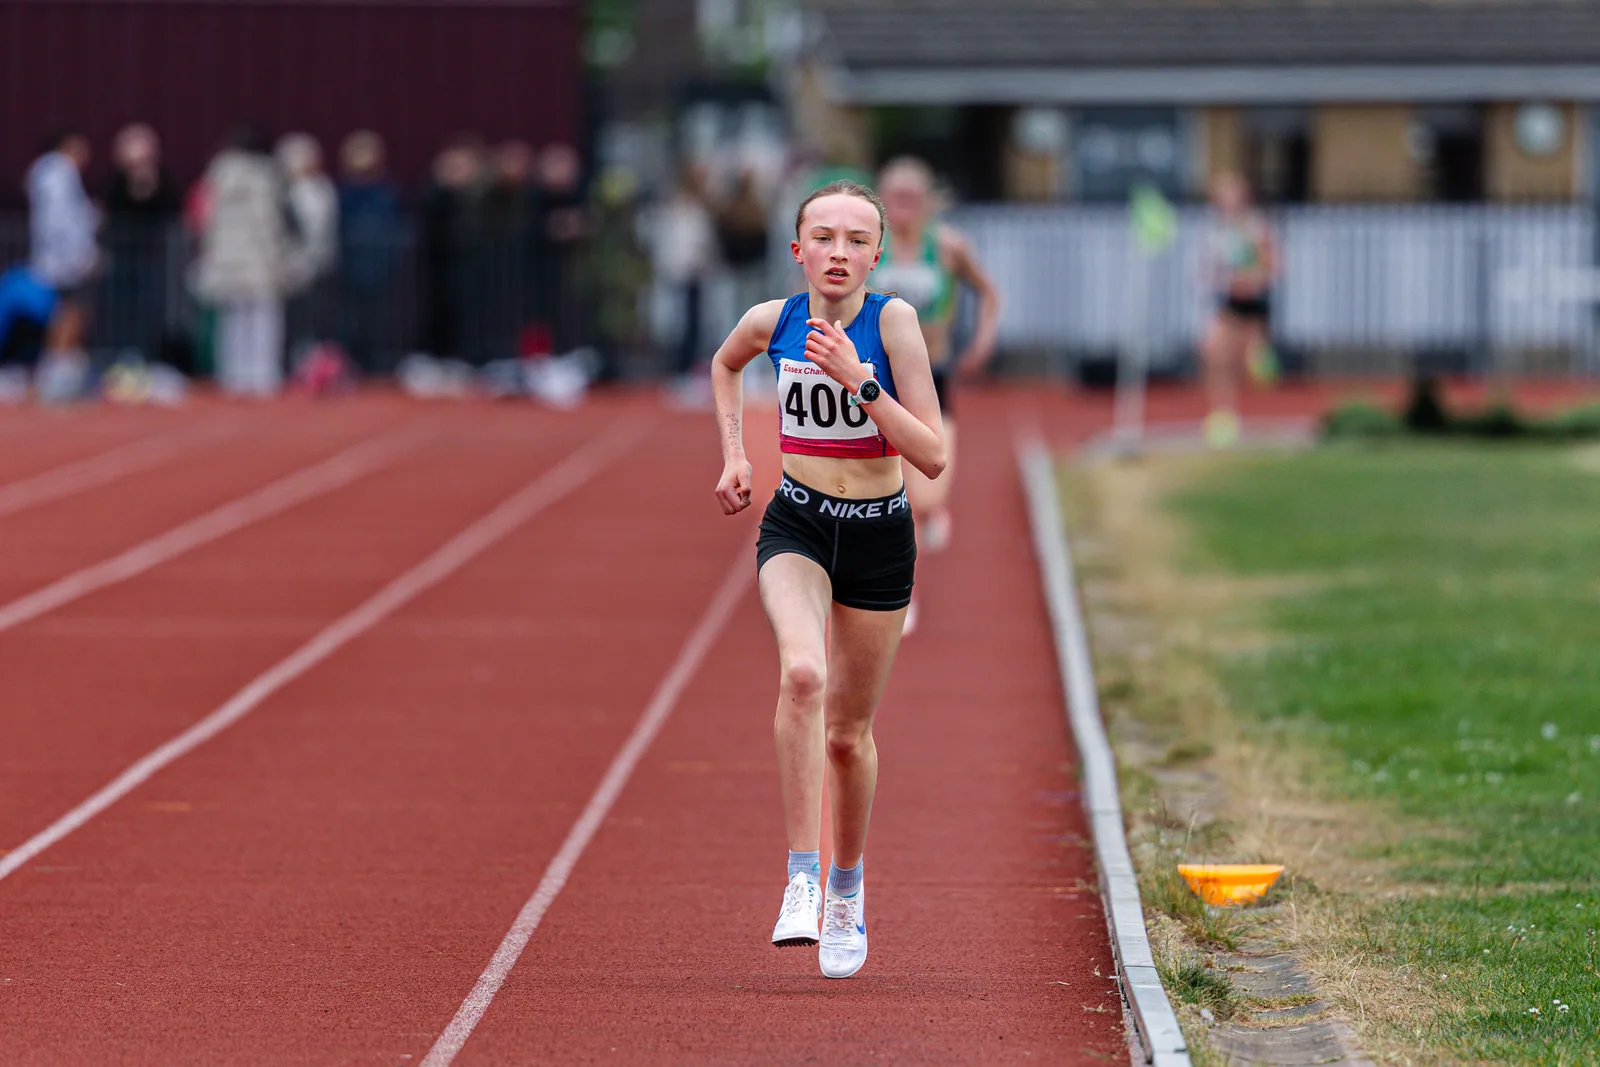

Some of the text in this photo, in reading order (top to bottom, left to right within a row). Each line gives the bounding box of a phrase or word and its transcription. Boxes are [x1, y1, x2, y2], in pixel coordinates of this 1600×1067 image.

[783, 364, 829, 378] Essex Cham
[785, 381, 869, 428] 406
[780, 475, 810, 505] RO
[819, 499, 884, 519] NIKE
